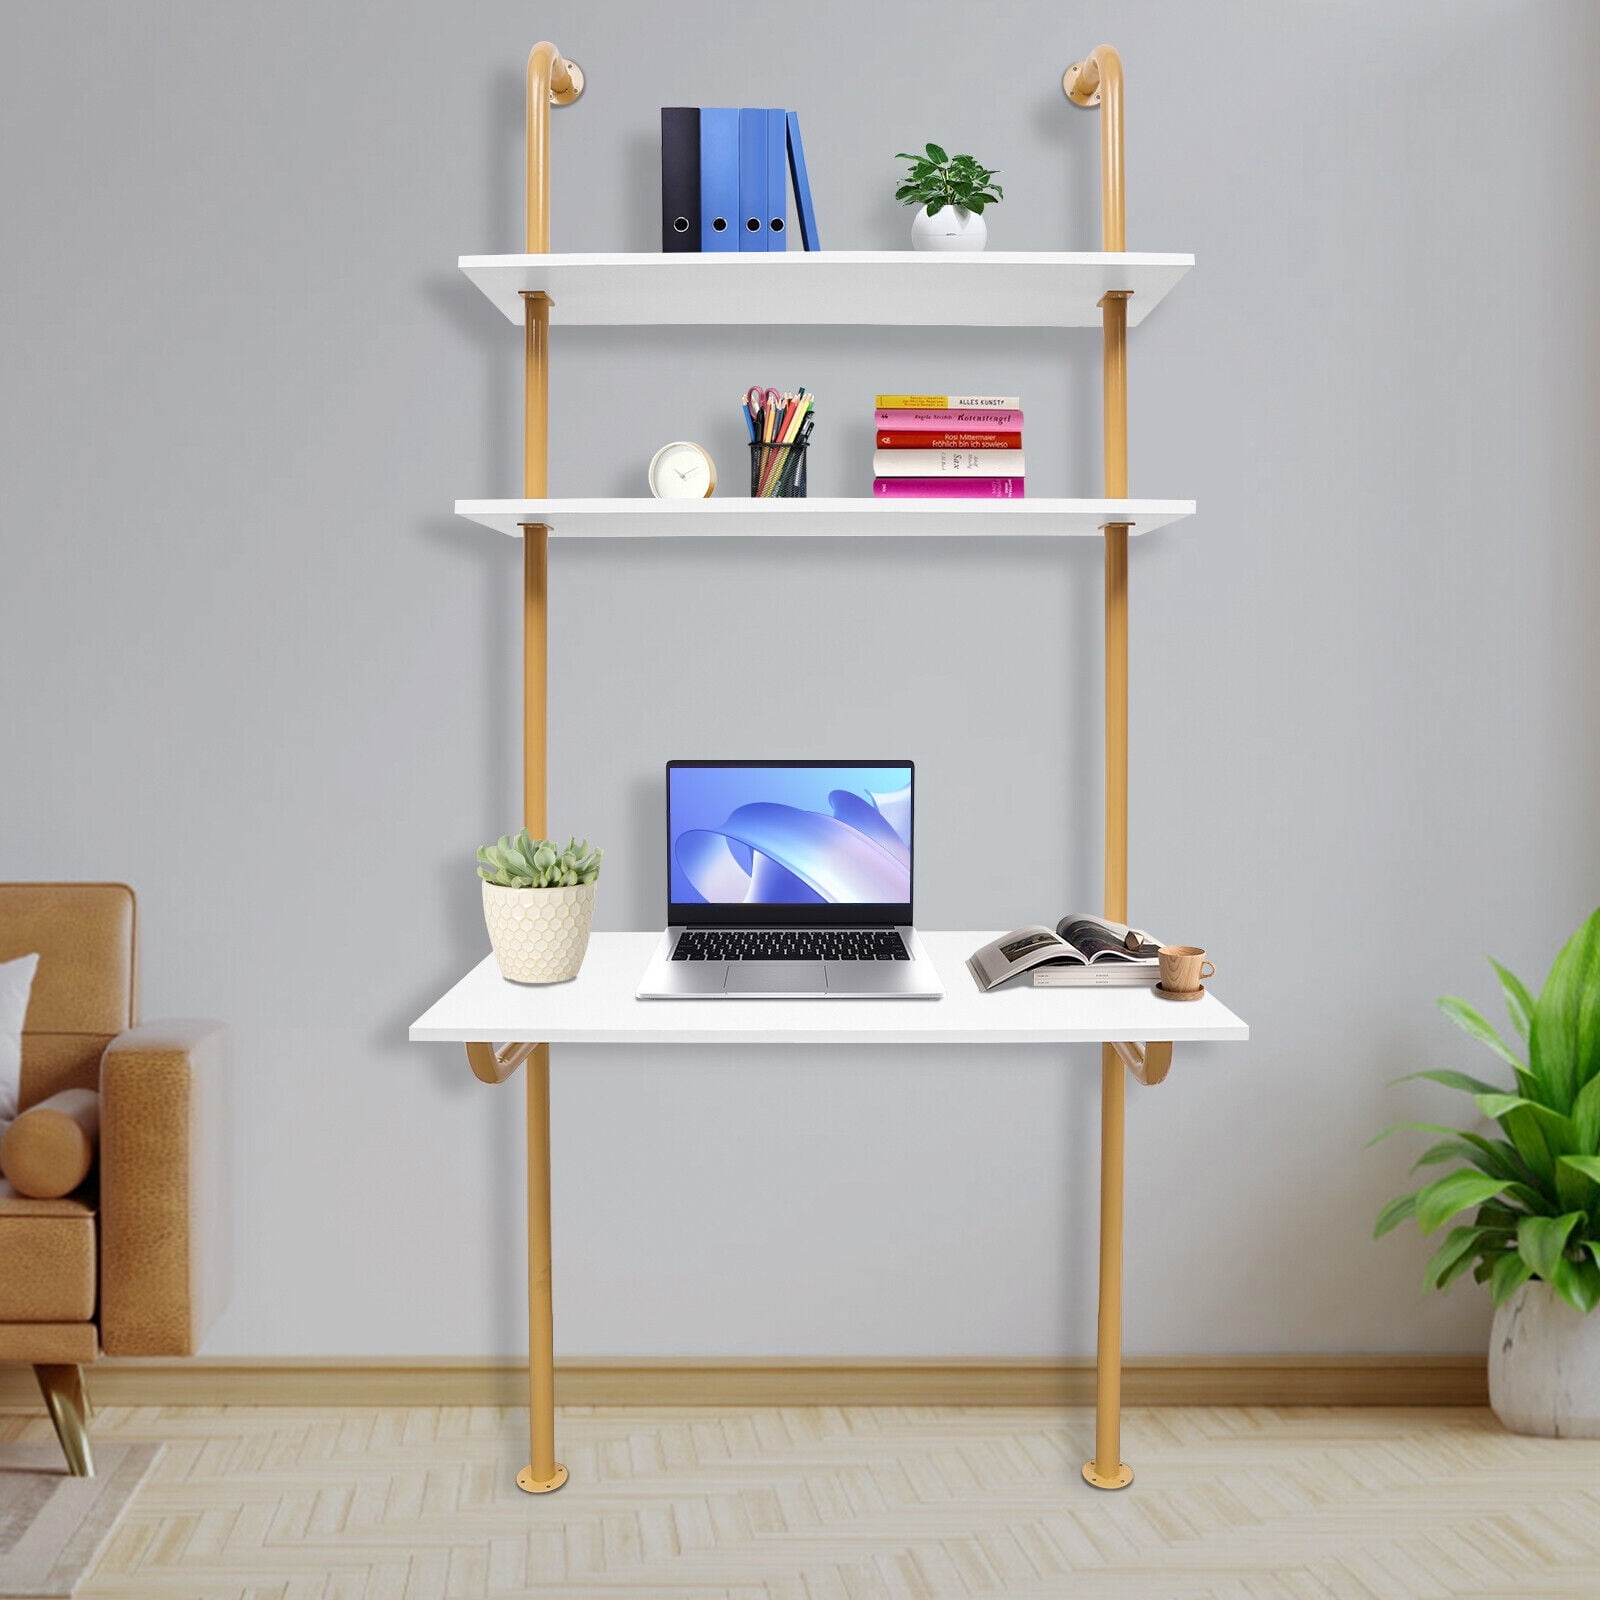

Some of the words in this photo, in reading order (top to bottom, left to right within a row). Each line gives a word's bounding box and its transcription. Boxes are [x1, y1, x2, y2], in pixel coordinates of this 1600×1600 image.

[932, 440, 958, 448] Fröhlich
[959, 440, 970, 448] bin
[970, 440, 981, 448] ich
[981, 440, 1009, 448] sowieso
[953, 453, 963, 470] Sax
